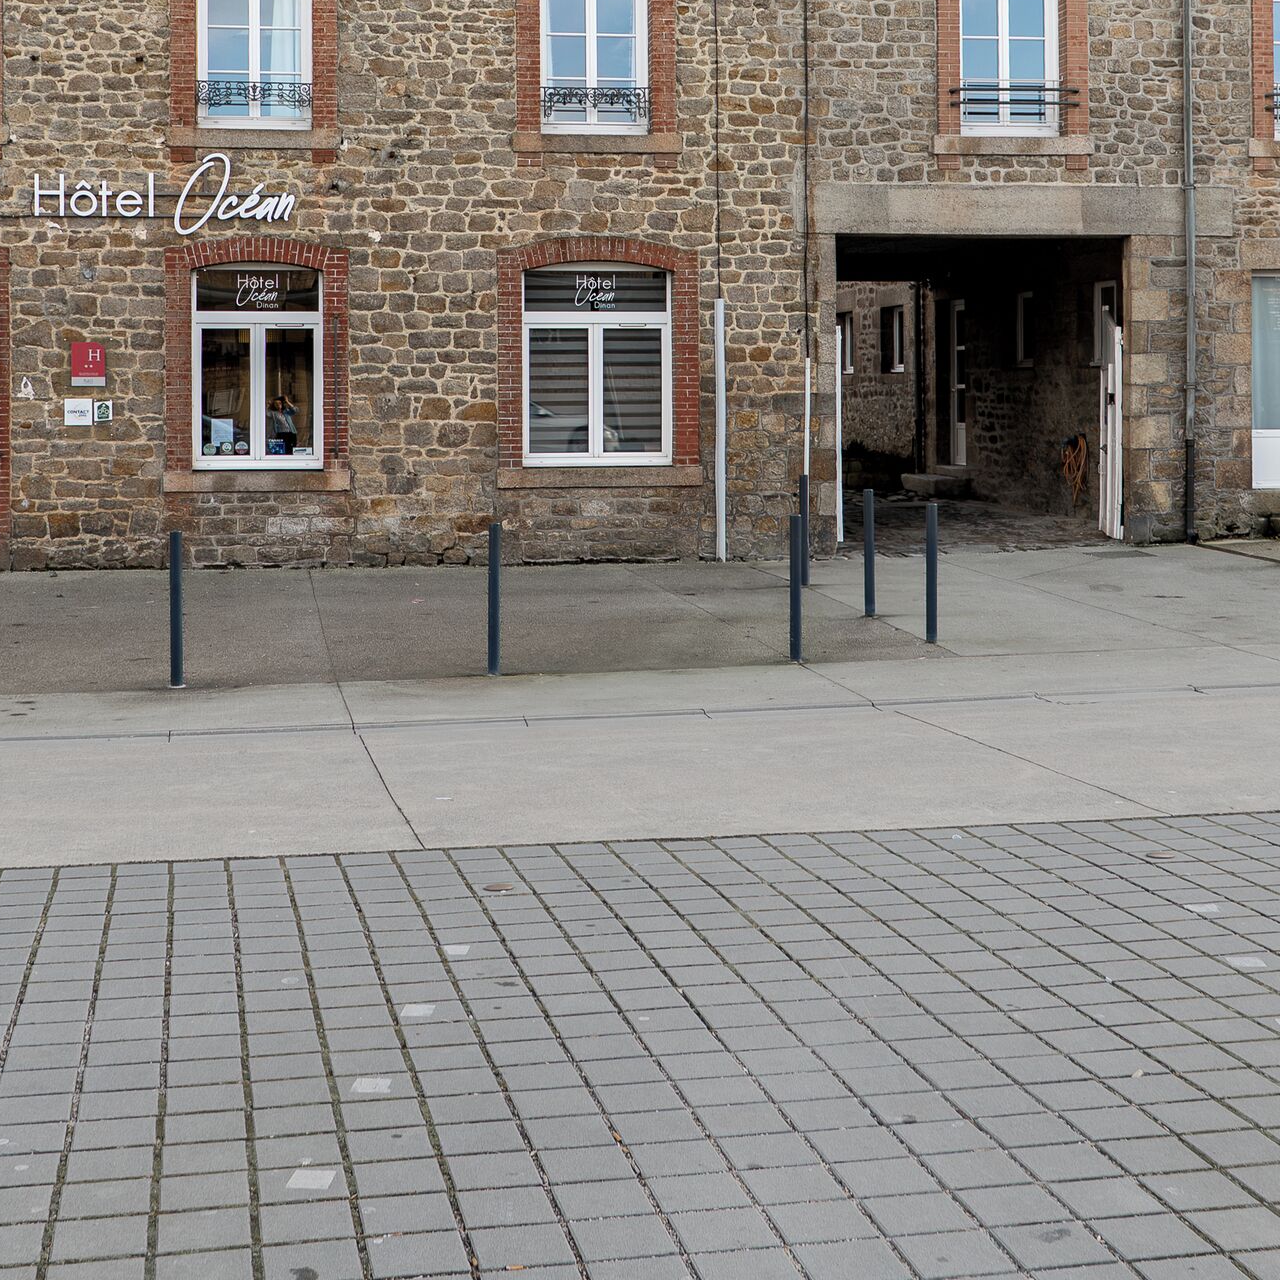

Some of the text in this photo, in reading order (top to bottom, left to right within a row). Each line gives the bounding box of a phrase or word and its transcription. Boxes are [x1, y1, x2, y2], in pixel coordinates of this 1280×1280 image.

[34, 153, 295, 235] Hôtel Océan
[237, 273, 279, 289] Hôtel
[576, 274, 615, 289] Hôtel
[236, 278, 278, 306] Océan
[256, 301, 279, 309] Dinan
[594, 301, 616, 309] Dinan
[88, 349, 100, 361] H
